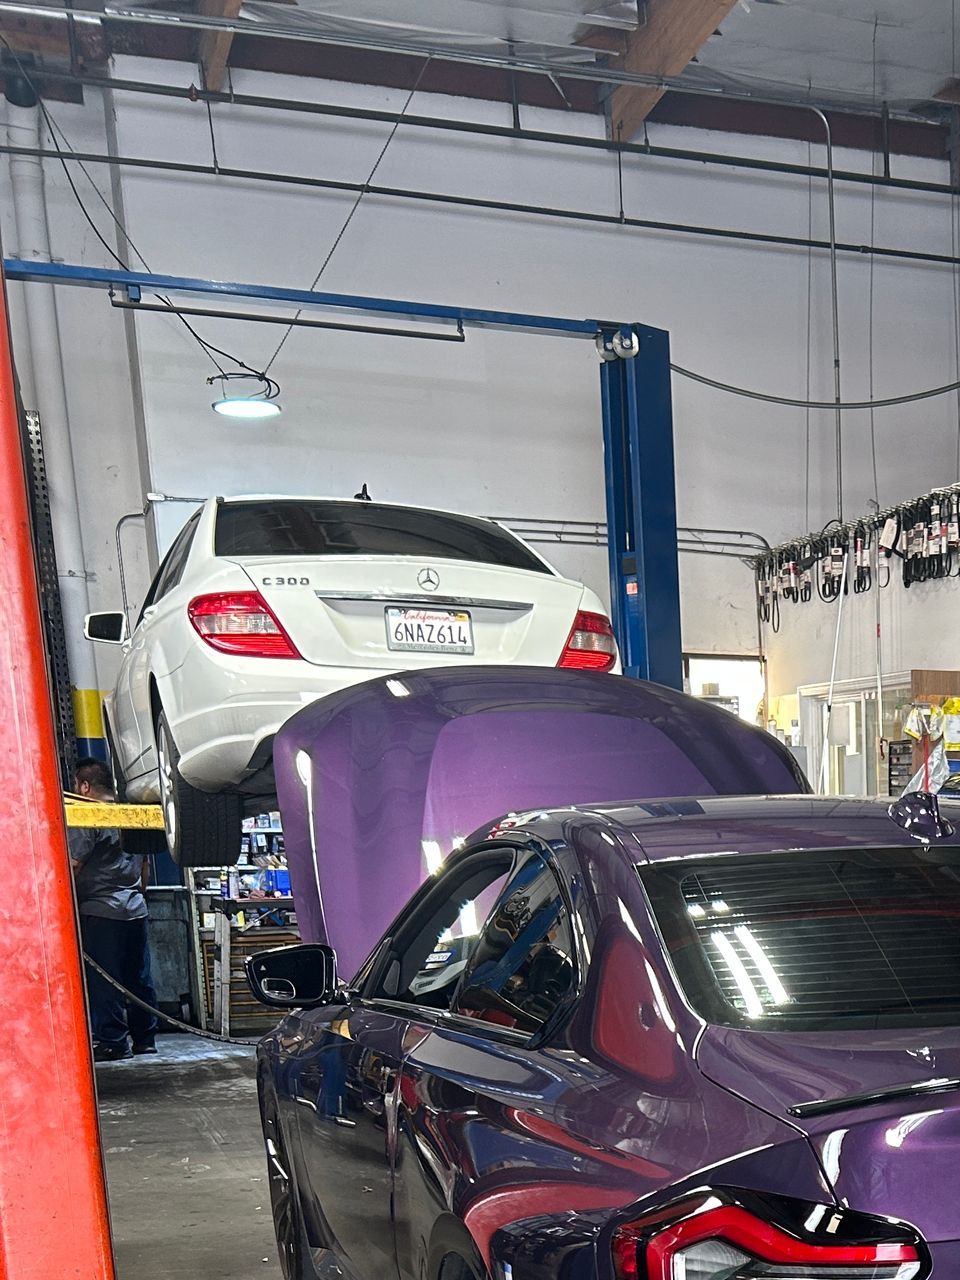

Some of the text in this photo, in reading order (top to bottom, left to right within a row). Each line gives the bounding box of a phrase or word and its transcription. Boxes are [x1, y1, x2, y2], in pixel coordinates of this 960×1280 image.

[262, 576, 310, 586] C 300
[403, 610, 451, 623] California
[394, 622, 468, 645] 6NAZ614
